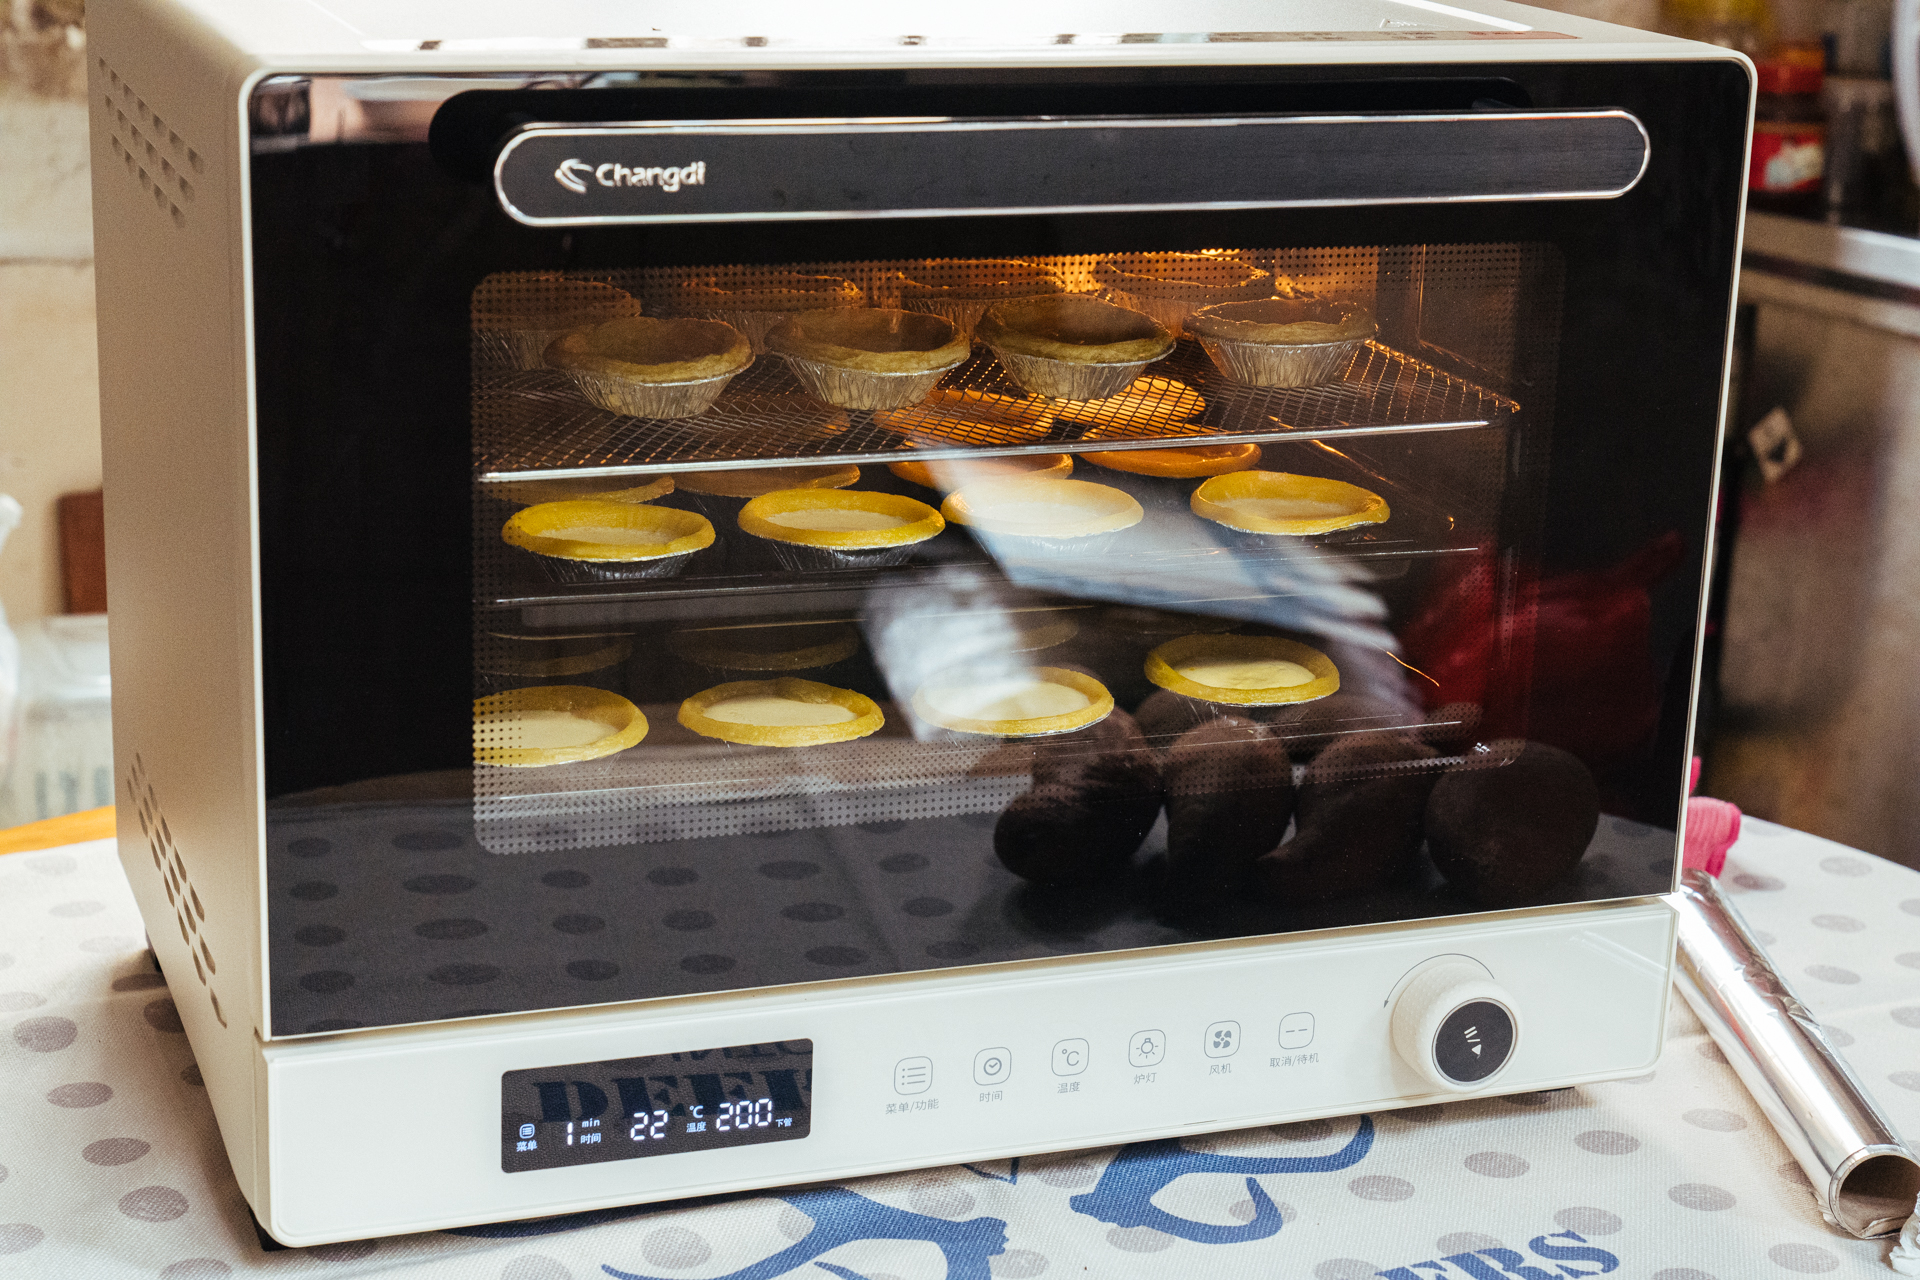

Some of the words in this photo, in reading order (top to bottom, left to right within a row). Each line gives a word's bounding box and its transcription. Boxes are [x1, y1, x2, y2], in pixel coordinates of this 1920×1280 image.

[595, 160, 707, 193] Changdi
[1269, 1052, 1320, 1068] 取消/待机
[1209, 1063, 1232, 1076] 风机
[1133, 1072, 1157, 1085] 炉灯
[1057, 1081, 1081, 1094] 温度
[979, 1090, 1003, 1103] 时间
[885, 1098, 940, 1115] 菜单/功能
[716, 1098, 772, 1131] 200
[581, 1118, 601, 1128] min
[630, 1109, 668, 1141] 22
[686, 1121, 707, 1133] 温度
[775, 1117, 793, 1128] 下管
[567, 1122, 573, 1146] 1
[580, 1133, 602, 1145] 时间
[516, 1140, 537, 1152] 菜单
